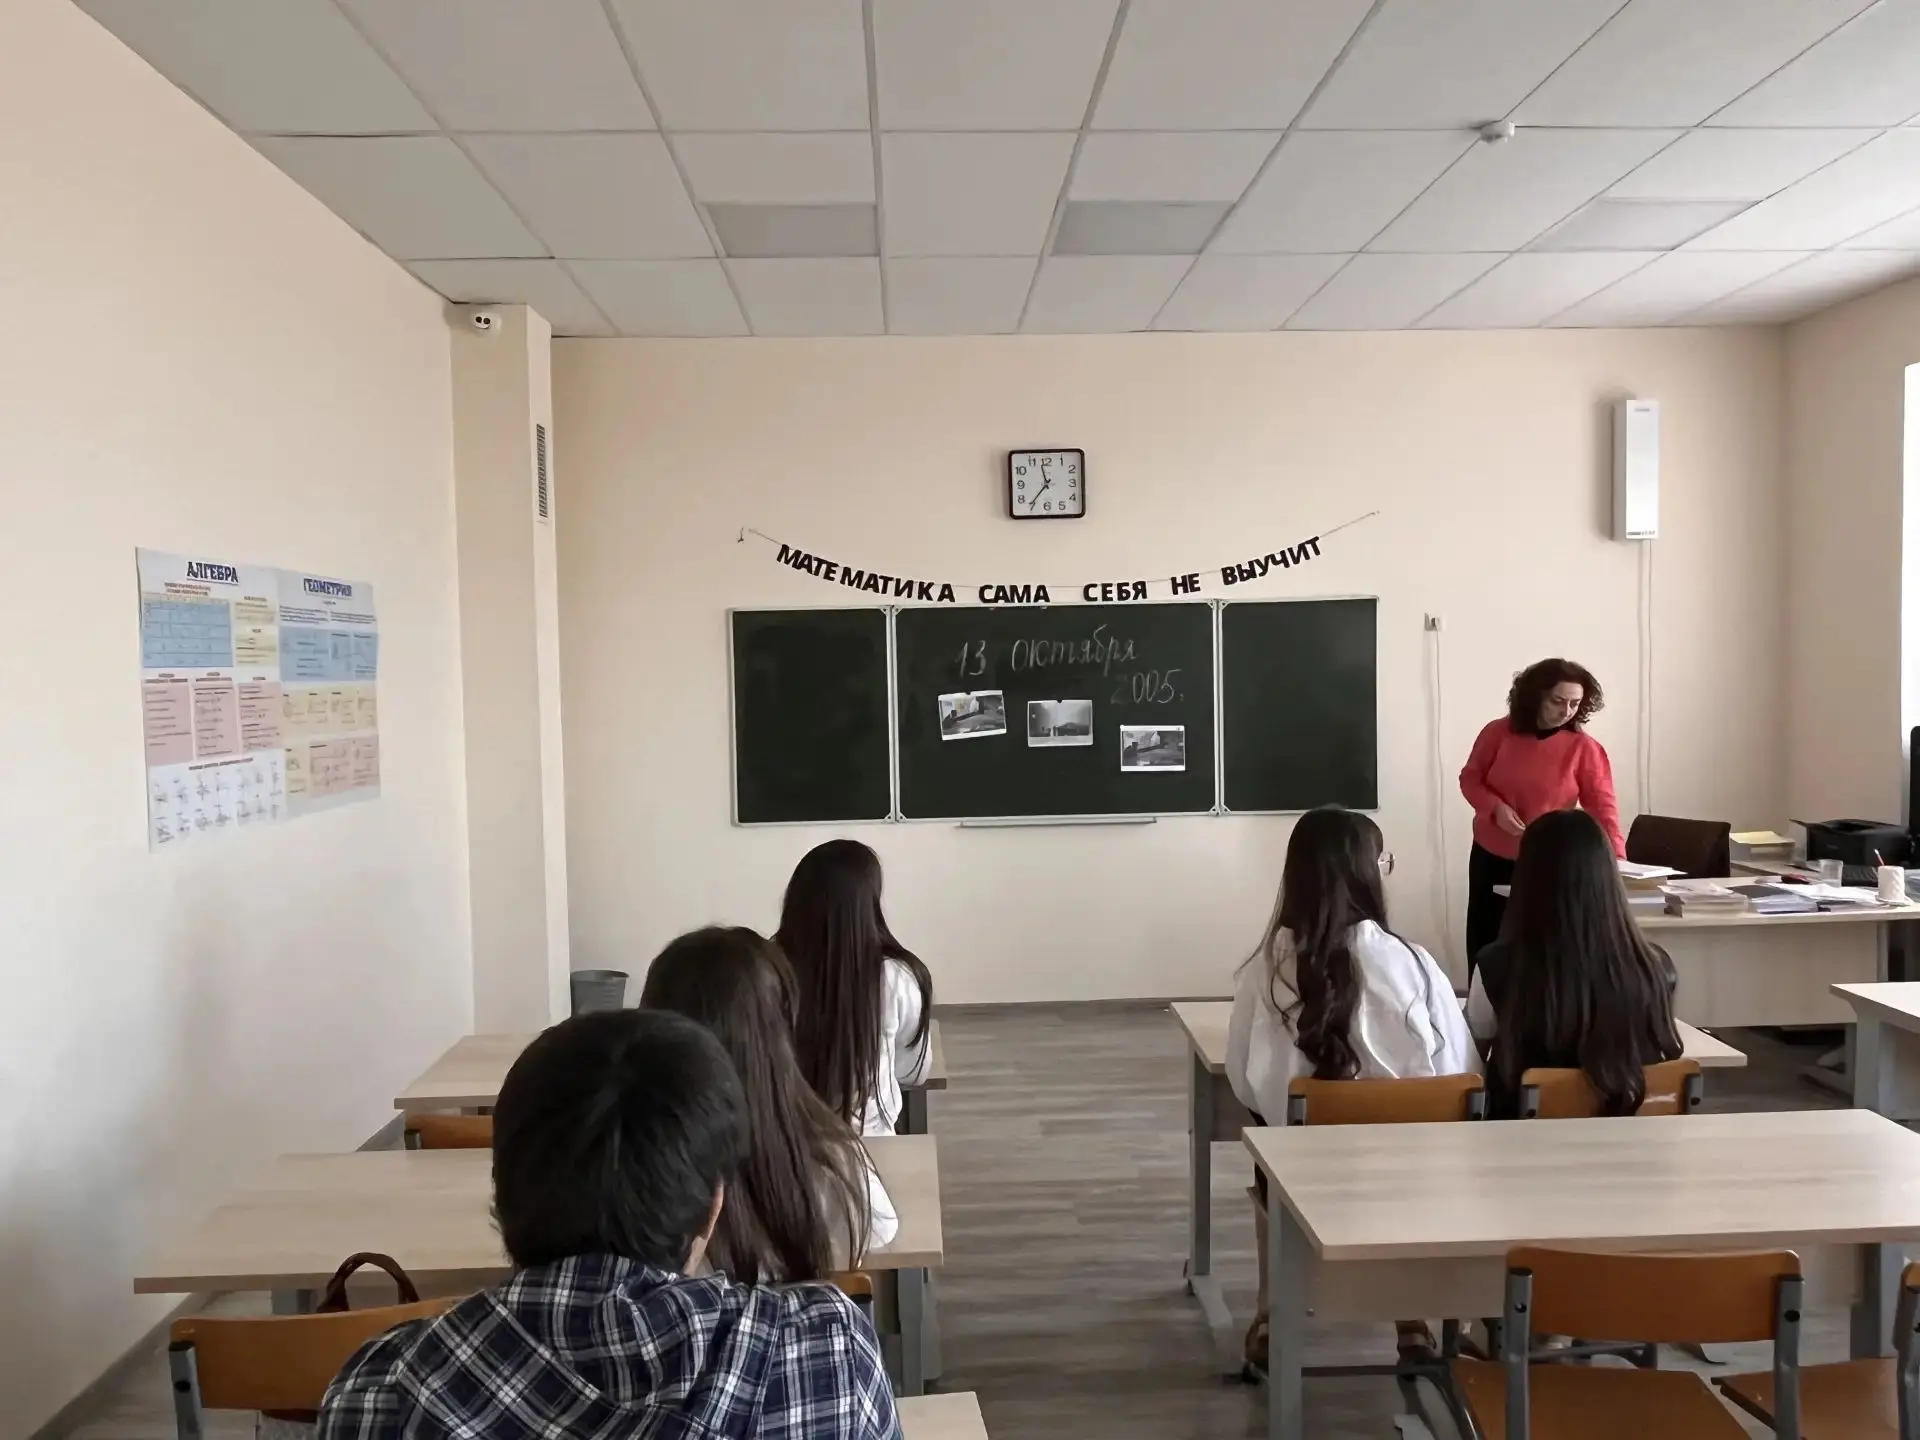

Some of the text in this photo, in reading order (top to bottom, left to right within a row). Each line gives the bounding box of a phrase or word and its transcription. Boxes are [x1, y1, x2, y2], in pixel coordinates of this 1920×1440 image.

[1028, 457, 1036, 467] 11
[1041, 457, 1053, 467] 12
[1060, 456, 1064, 467] 1
[1015, 466, 1027, 476] 10
[1068, 464, 1077, 474] 2
[1016, 480, 1026, 490] 9
[1068, 479, 1077, 488] 3
[1017, 494, 1026, 504] 8
[1069, 492, 1077, 501] 4
[1043, 501, 1052, 511] 6
[1058, 500, 1067, 511] 5
[186, 561, 239, 583] АЛГЕБРА
[777, 536, 1322, 604] МАТЕМАТИКА САМА СЕБЯ НЕ ВЫУЧИТ
[303, 578, 353, 598] ГЕОМЕТРИЯ
[955, 639, 987, 678] 13
